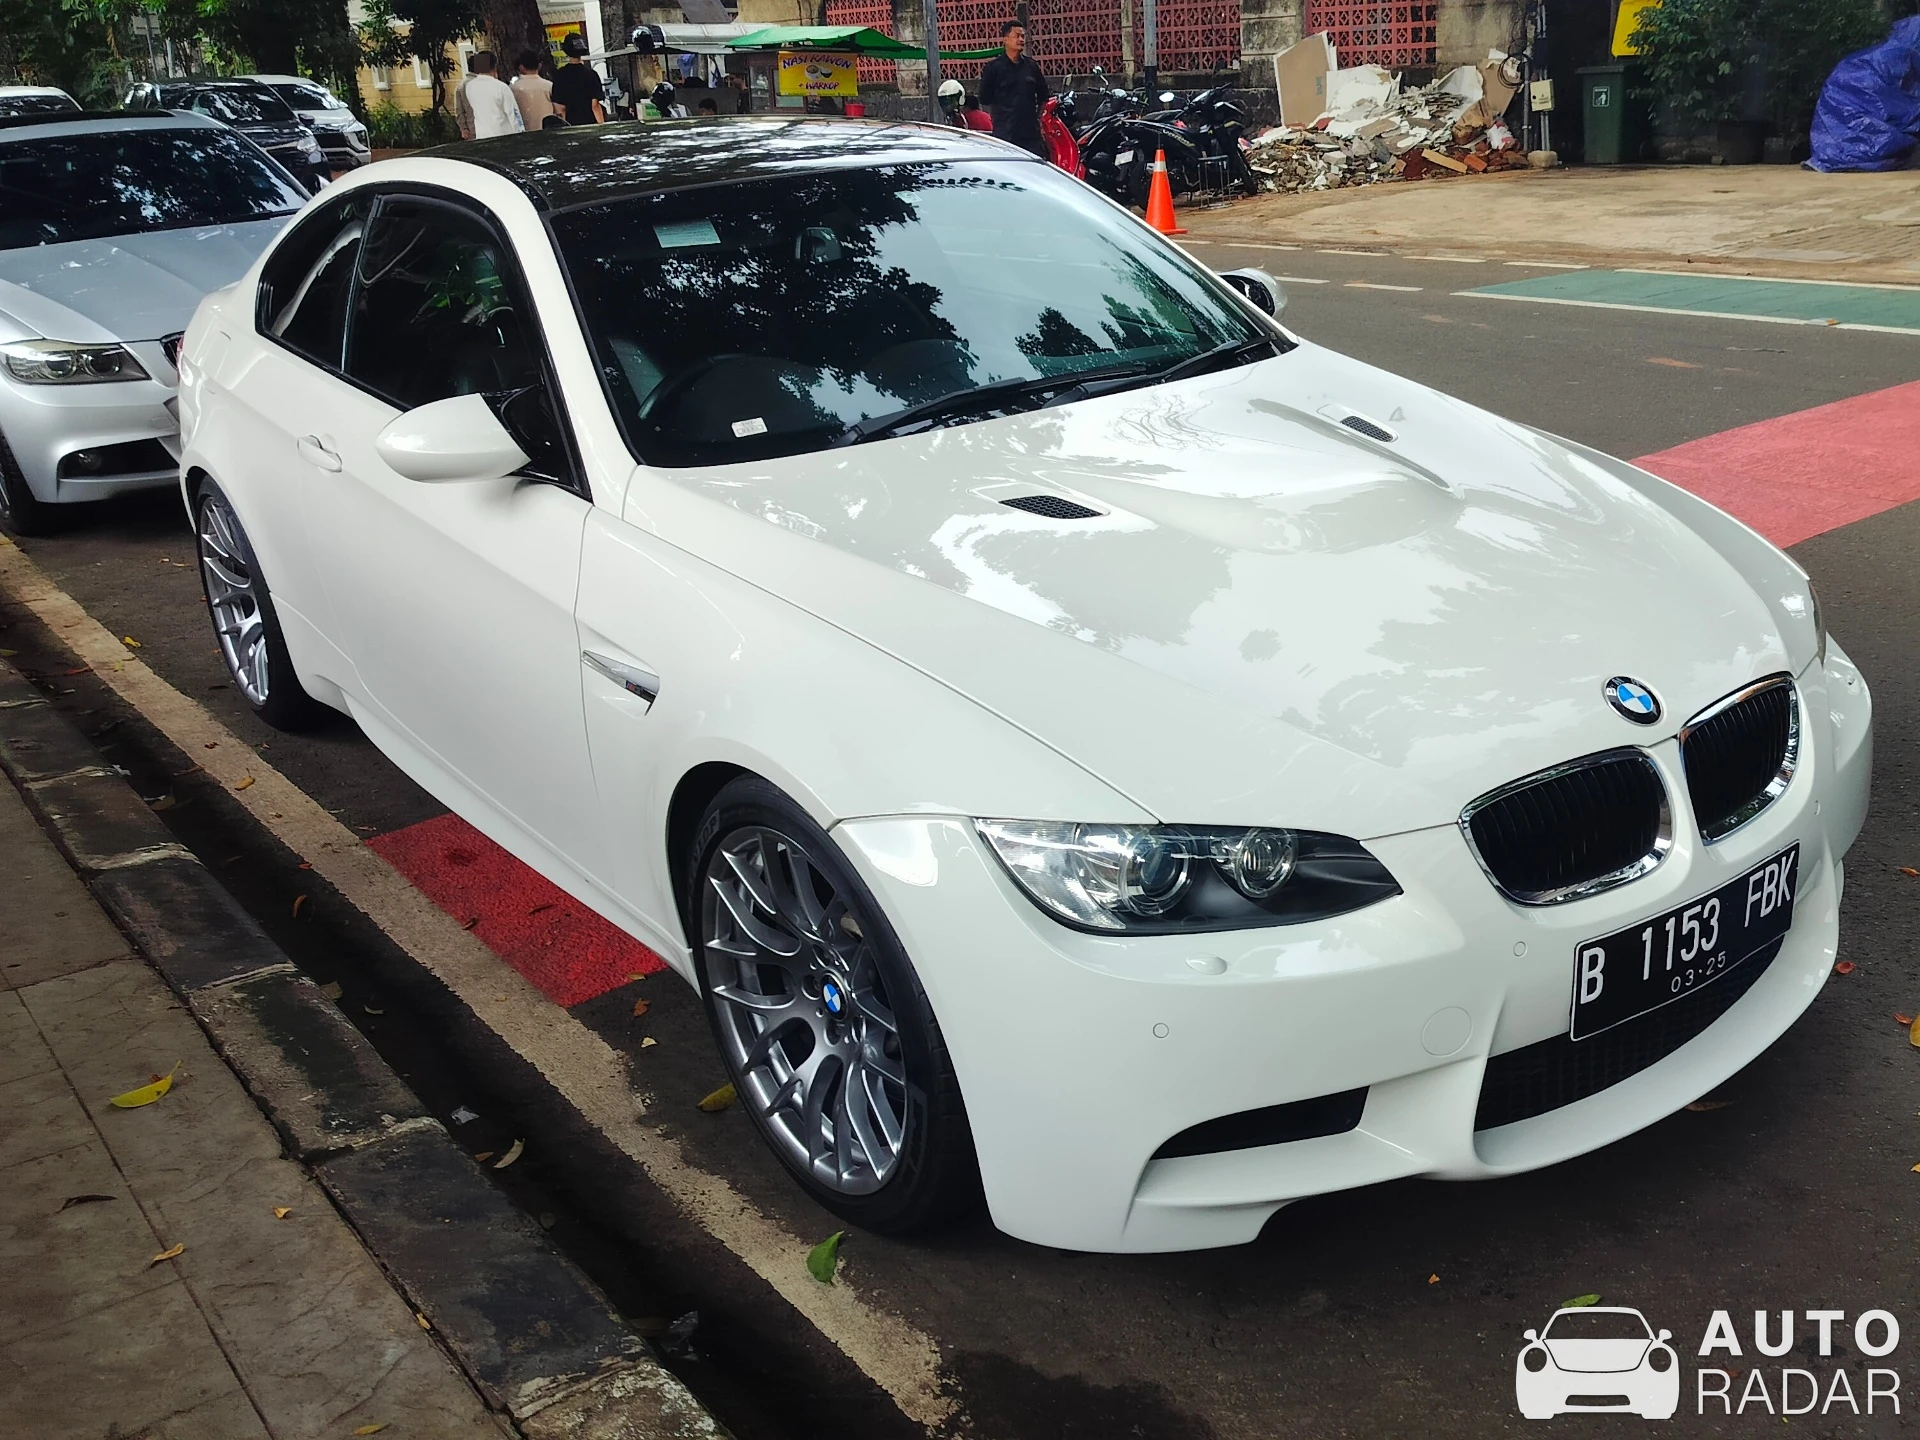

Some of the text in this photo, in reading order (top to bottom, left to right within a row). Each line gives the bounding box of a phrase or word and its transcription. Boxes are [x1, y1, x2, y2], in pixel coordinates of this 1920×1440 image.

[782, 54, 852, 69] NASI RAWON
[805, 82, 840, 90] WARKOP
[1580, 850, 1796, 1005] B 1153 FBK
